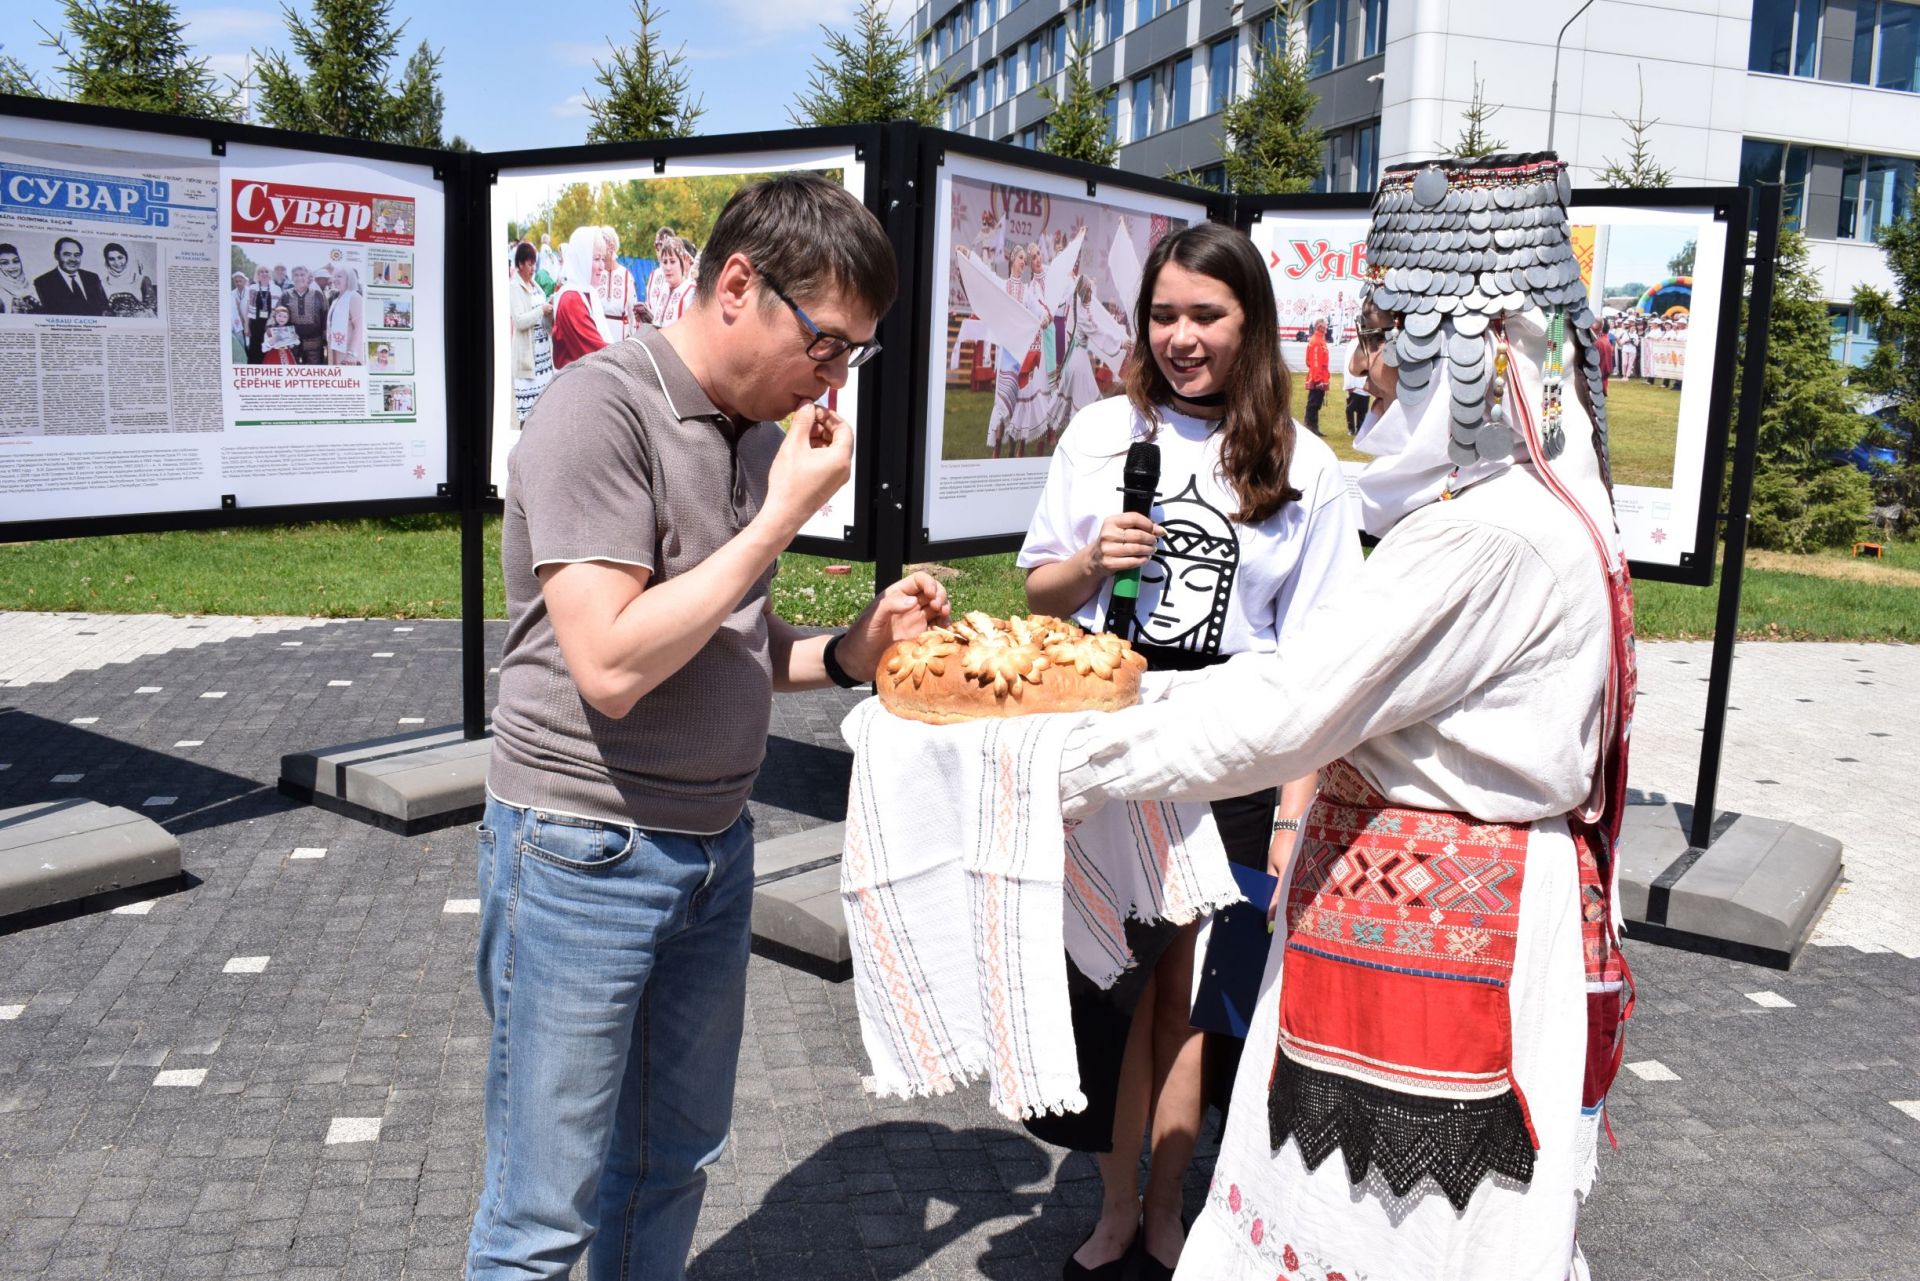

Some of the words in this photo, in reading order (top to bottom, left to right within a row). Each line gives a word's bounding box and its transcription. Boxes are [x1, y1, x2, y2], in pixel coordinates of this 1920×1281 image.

[8, 175, 140, 213] СУВАР
[236, 184, 371, 240] Сувар
[1009, 219, 1033, 236] 2022
[232, 367, 283, 377] ТЕПРИНЕ
[286, 366, 342, 377] ХУСАНКАЙ
